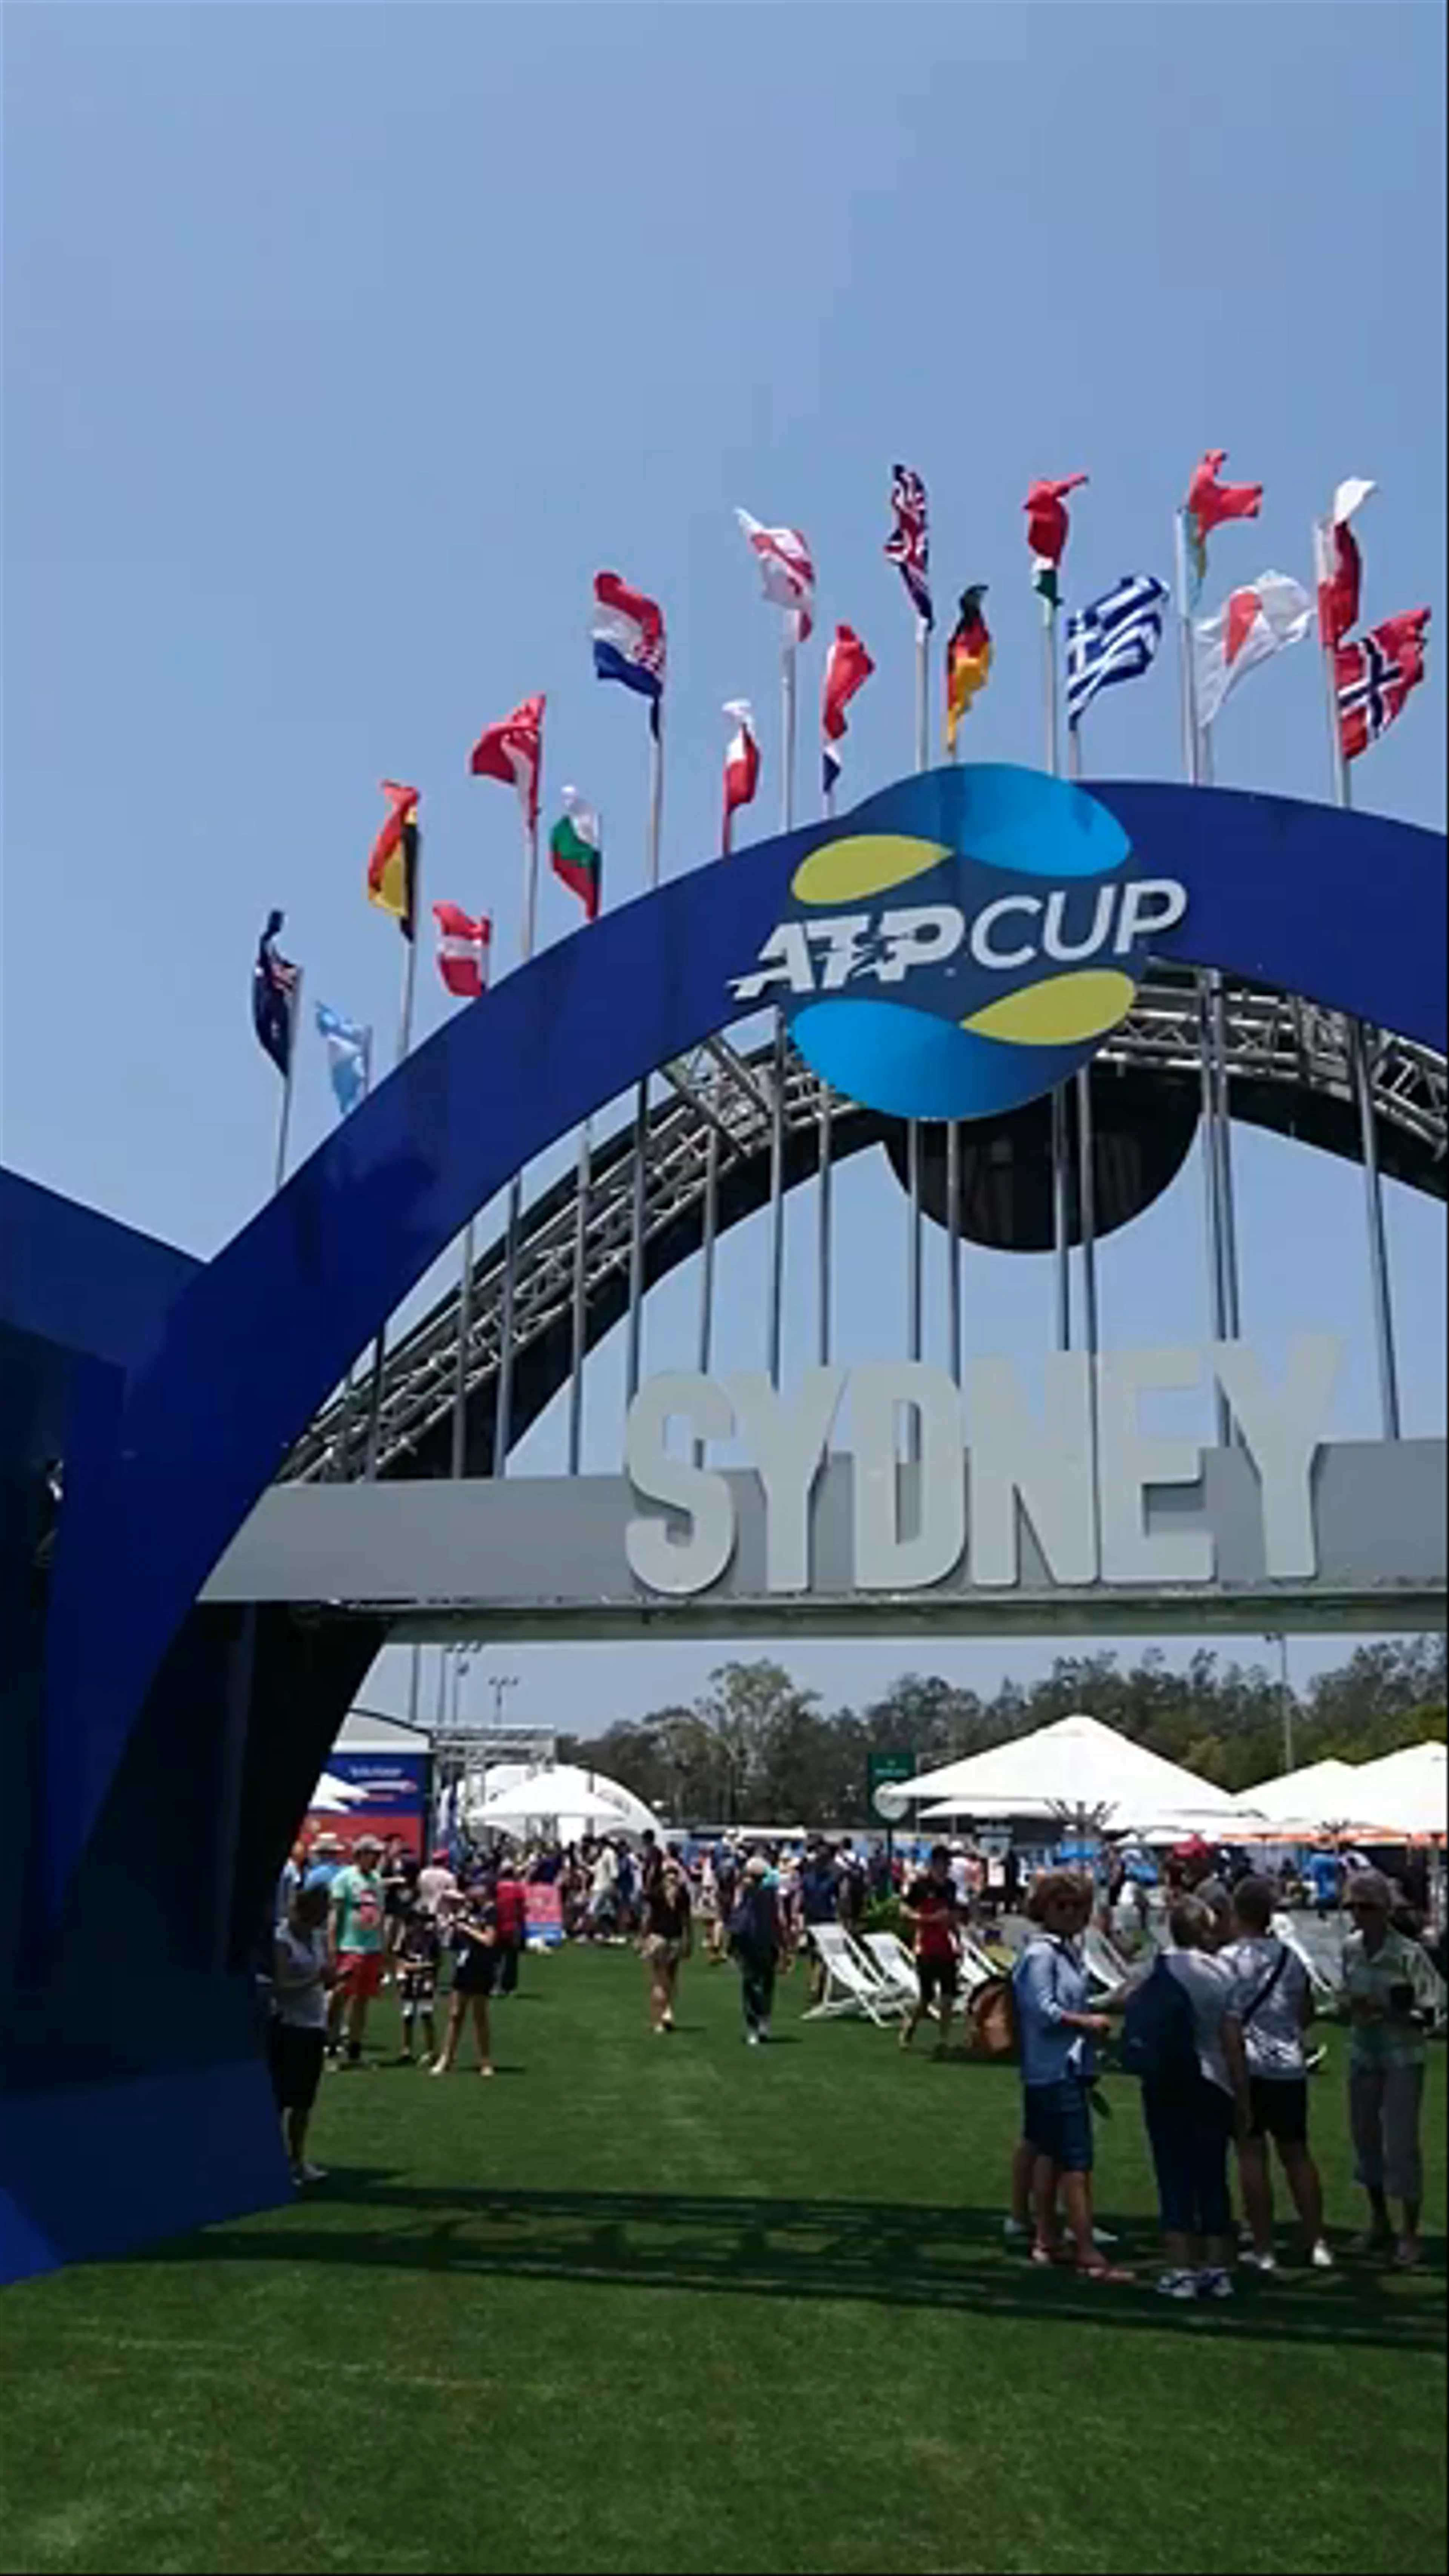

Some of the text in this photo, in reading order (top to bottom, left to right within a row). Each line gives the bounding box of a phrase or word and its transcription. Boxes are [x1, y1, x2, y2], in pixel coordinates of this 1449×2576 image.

[728, 880, 1187, 999] ATP CUP
[625, 1333, 1342, 1595] SYDNEY
